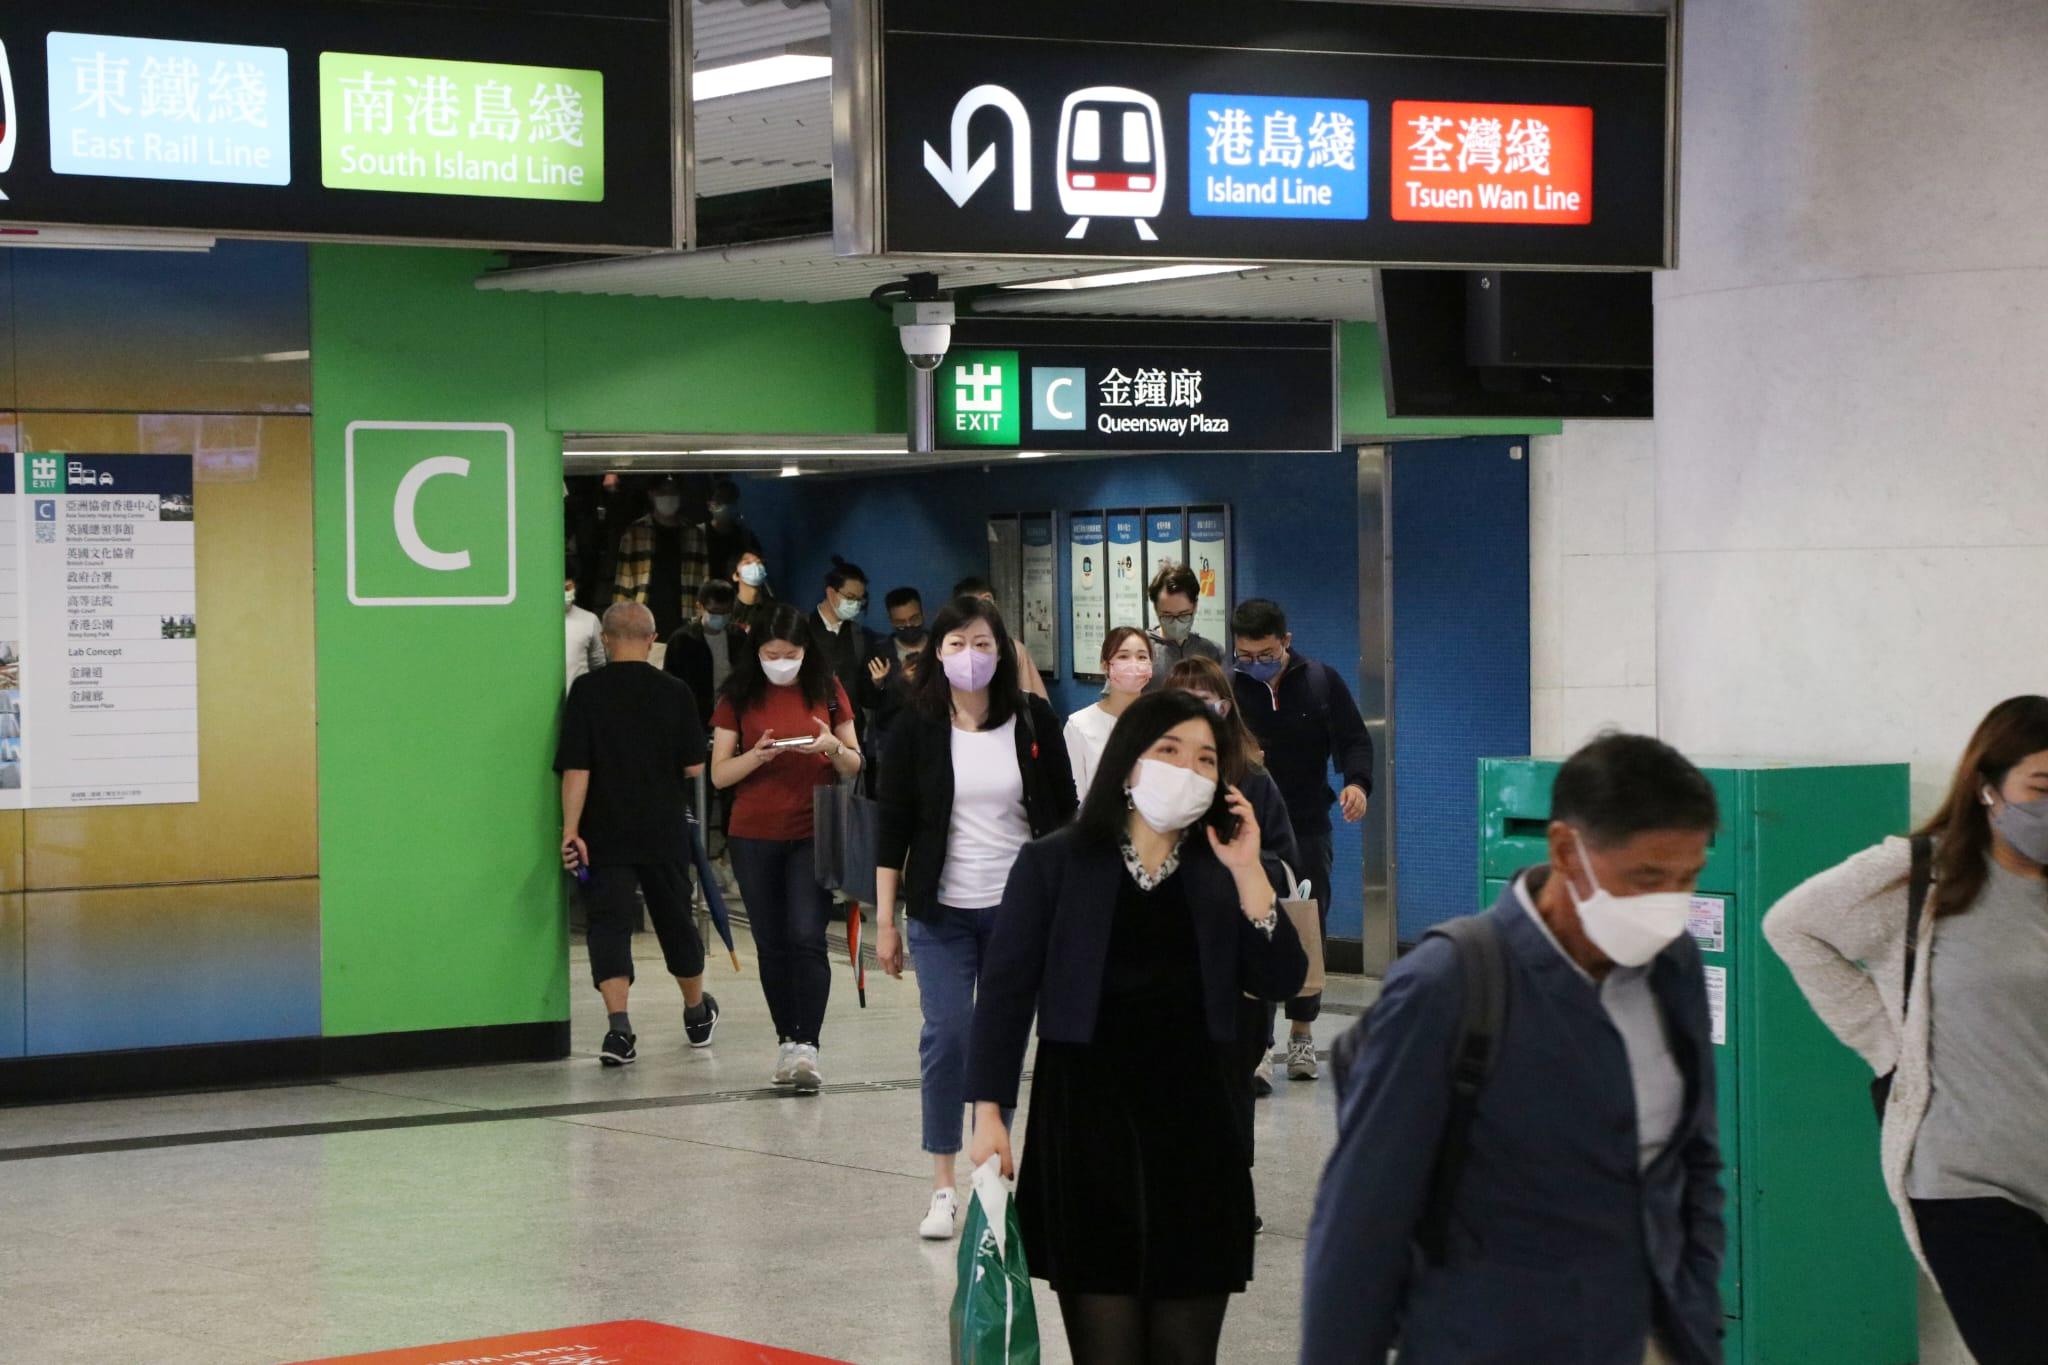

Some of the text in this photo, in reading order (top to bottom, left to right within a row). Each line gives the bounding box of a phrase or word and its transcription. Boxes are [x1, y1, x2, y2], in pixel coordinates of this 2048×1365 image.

[70, 52, 270, 129] 東鐵綫
[338, 71, 585, 148] 南港島綫
[71, 129, 271, 168] East Rail Line
[1206, 109, 1356, 171] 港島綫
[1408, 115, 1551, 176] 荃灣綫
[340, 145, 585, 187] South Island Line
[1207, 176, 1332, 206] Island Line
[1406, 182, 1580, 211] Tsuen Wan Line
[955, 363, 1002, 411] 出
[1046, 378, 1073, 420] C
[1099, 368, 1202, 408] 金鐘廊
[955, 413, 1002, 431] EXIT
[1098, 414, 1229, 436] Queensway Plaza
[33, 480, 56, 488] EXIT
[39, 503, 51, 518] C
[393, 455, 472, 571] C
[68, 648, 122, 658] Lab Concept
